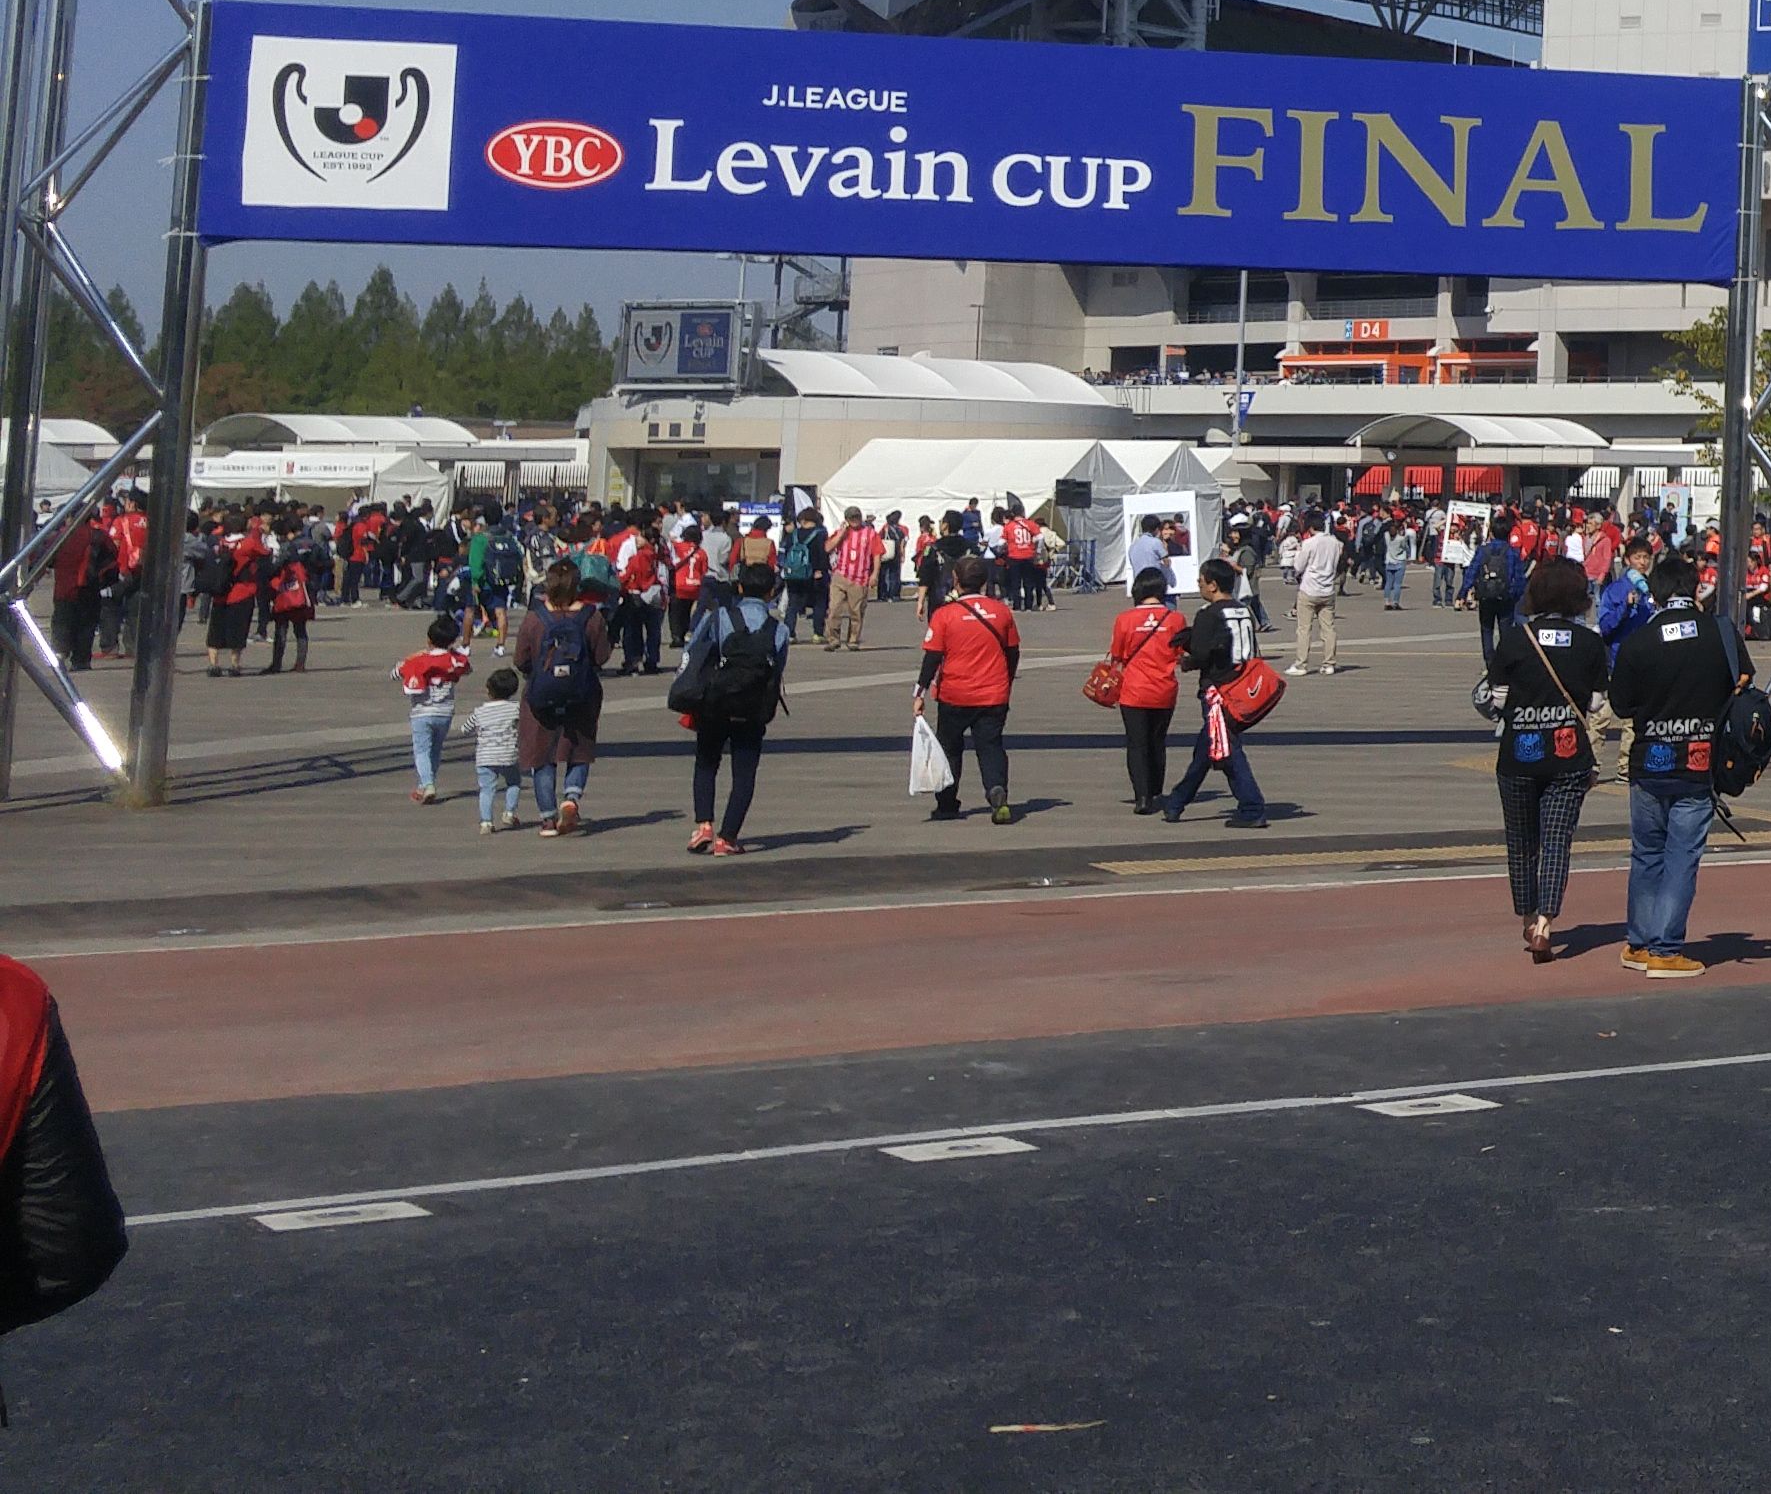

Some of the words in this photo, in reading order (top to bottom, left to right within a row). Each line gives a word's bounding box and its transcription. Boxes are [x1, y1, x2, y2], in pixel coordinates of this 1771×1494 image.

[762, 85, 908, 113] J.LEAGUE
[511, 133, 601, 177] YBC
[645, 118, 974, 204] Levain
[993, 153, 1152, 210] CUP
[1177, 103, 1709, 233] FINAL
[1361, 321, 1380, 338] D4
